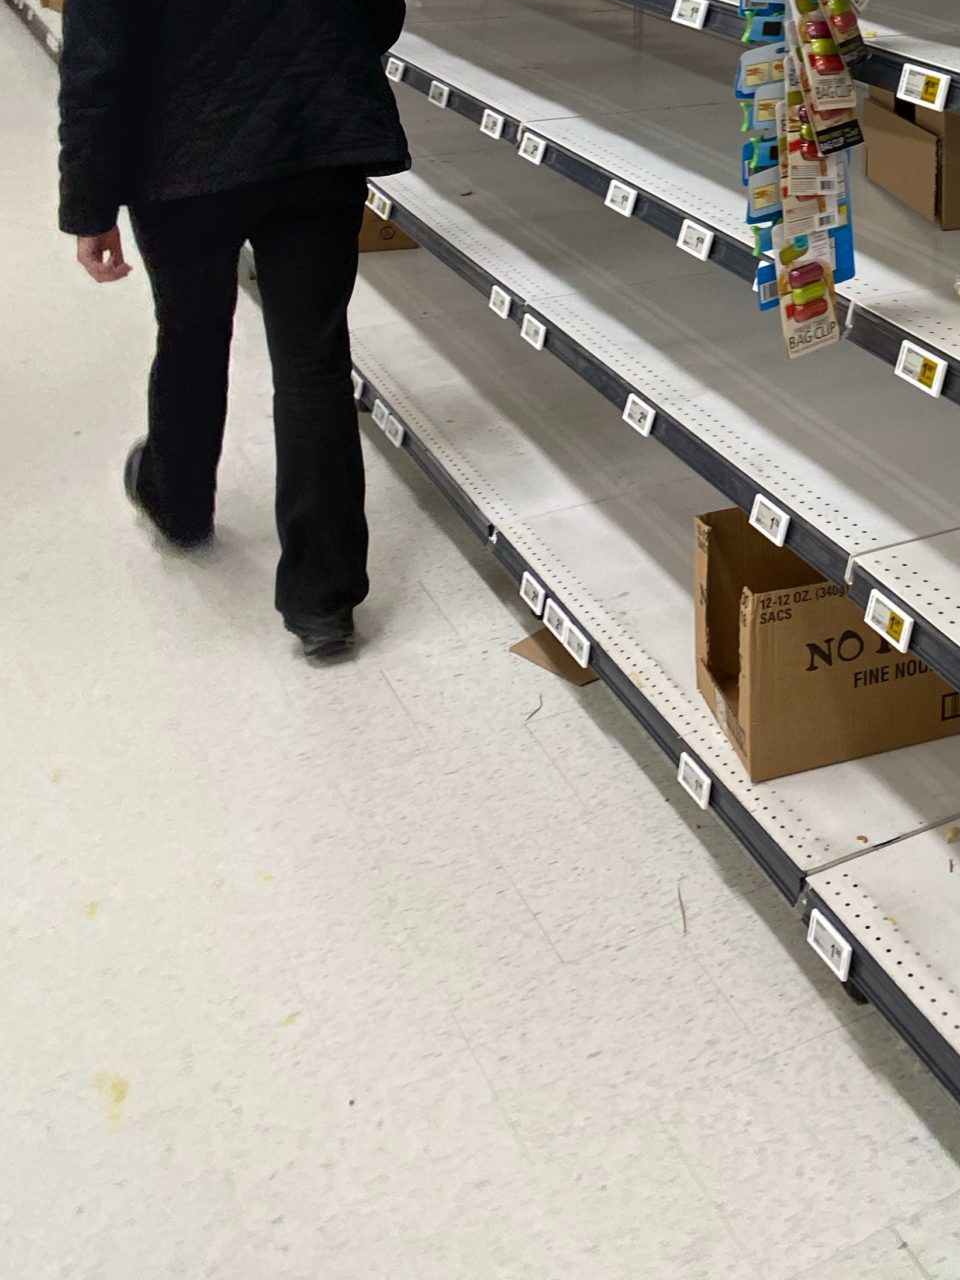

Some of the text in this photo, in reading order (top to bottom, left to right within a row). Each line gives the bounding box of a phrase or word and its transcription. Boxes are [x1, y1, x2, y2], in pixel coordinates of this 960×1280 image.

[759, 594, 791, 611] 12-12
[759, 607, 793, 626] SACS
[853, 665, 890, 689] FINE
